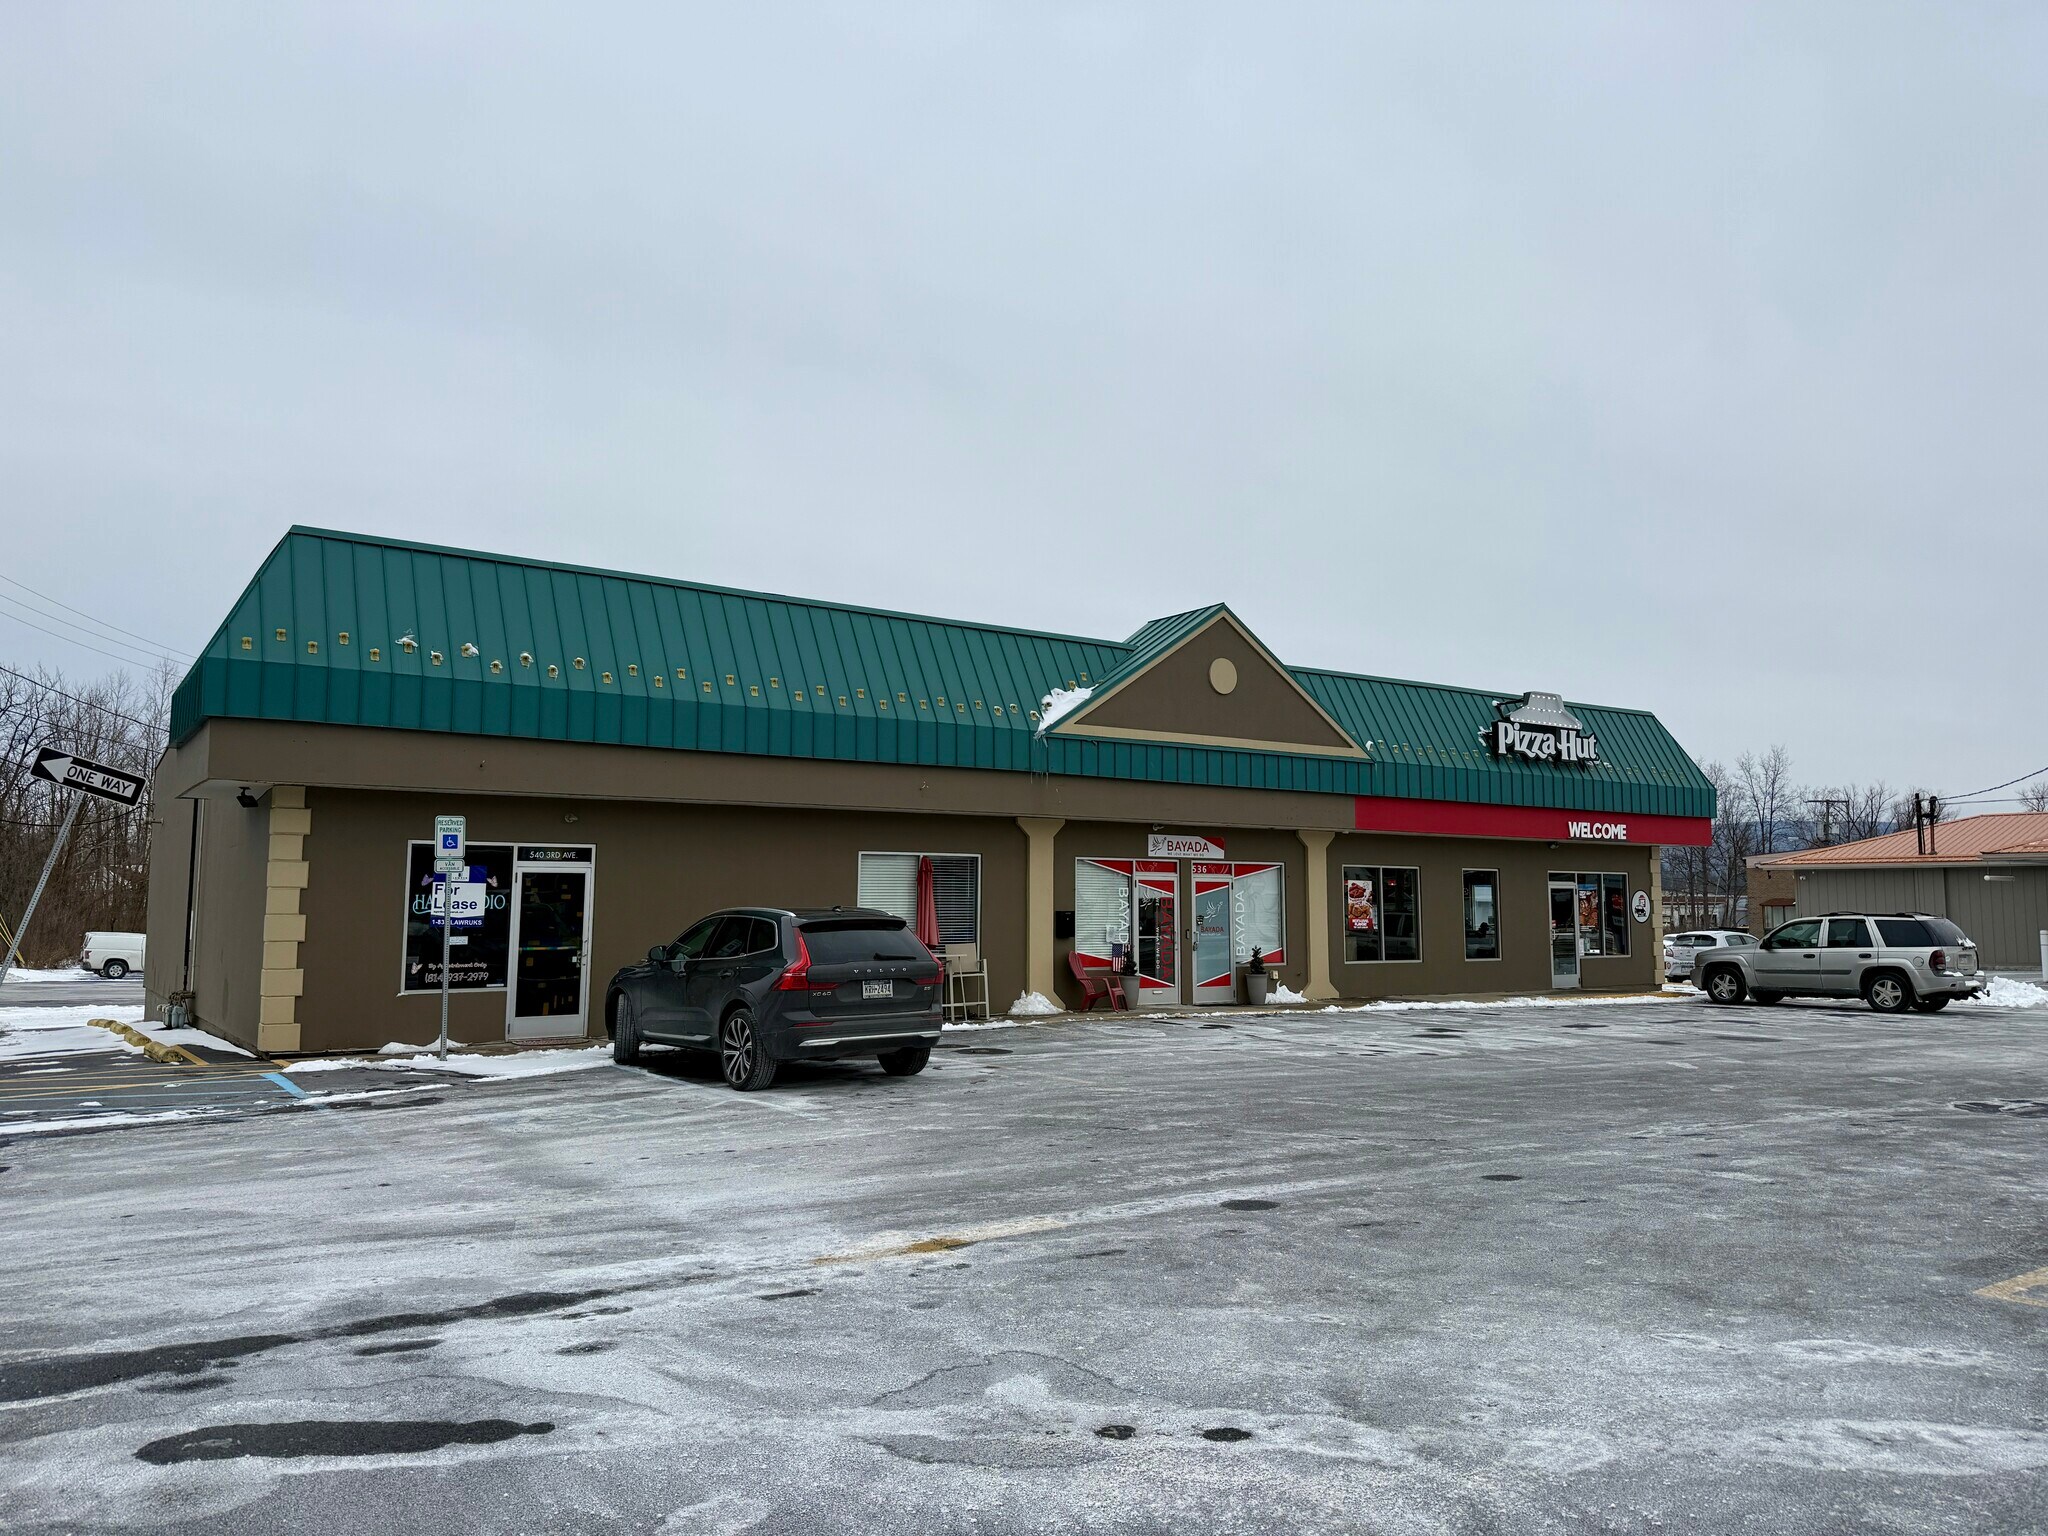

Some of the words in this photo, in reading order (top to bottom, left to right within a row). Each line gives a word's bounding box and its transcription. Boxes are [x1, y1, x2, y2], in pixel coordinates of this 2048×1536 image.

[1498, 721, 1556, 759] Pizza
[1557, 729, 1597, 761] Hut
[66, 765, 97, 784] ONE
[100, 775, 131, 794] WAY
[1167, 840, 1210, 853] BAYADA
[1568, 821, 1627, 840] WELCOME
[529, 850, 545, 859] 540
[546, 851, 561, 859] 3RD
[562, 851, 579, 859] AVE.
[1118, 887, 1129, 944] BAYAD
[1235, 890, 1246, 956] BAYADA
[1160, 896, 1173, 980] BAYADA
